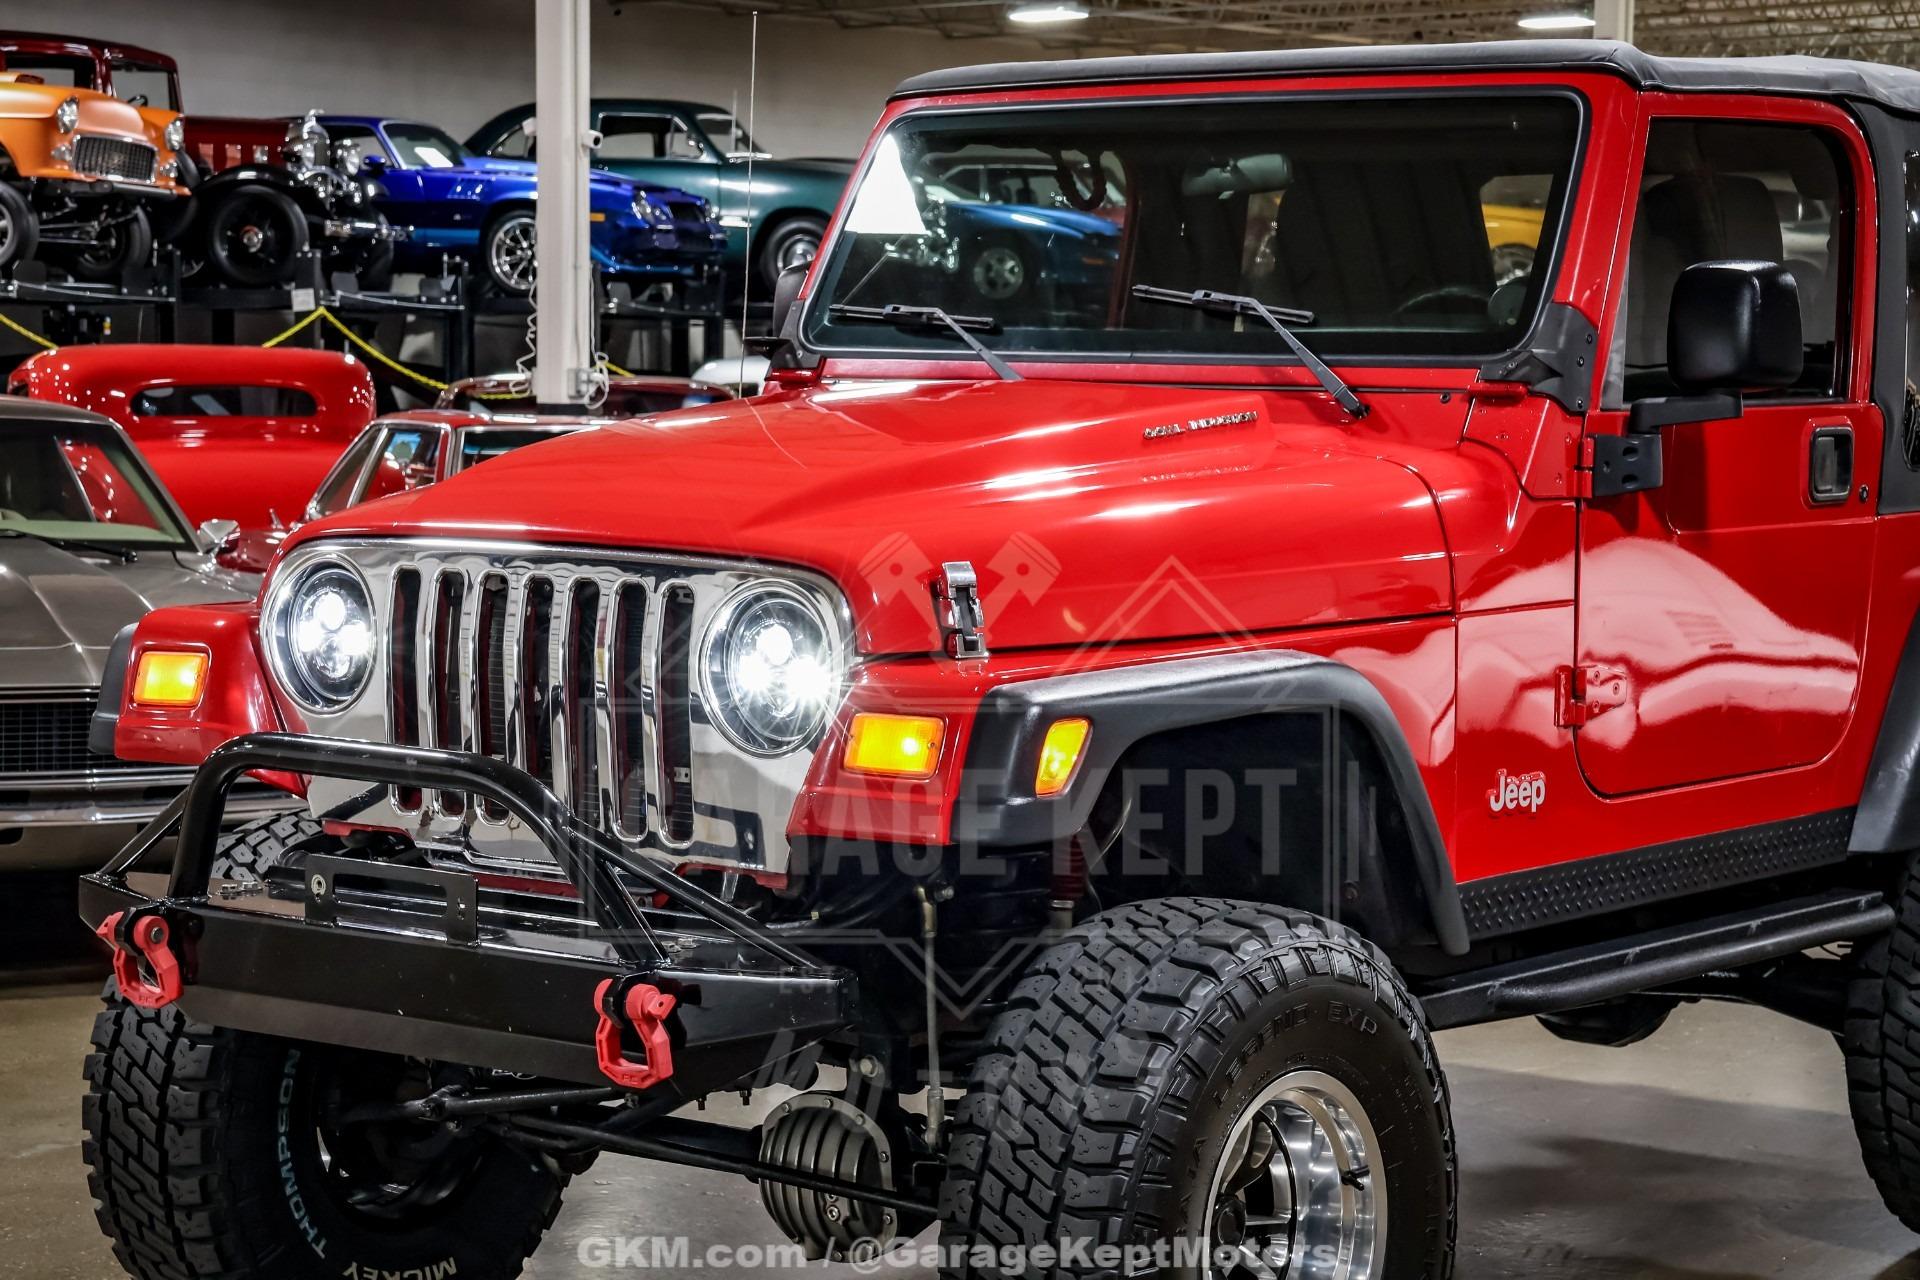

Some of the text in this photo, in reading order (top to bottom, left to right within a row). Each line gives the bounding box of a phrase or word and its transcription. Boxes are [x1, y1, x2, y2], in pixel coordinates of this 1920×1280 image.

[1486, 769, 1547, 813] Jeep
[1326, 1001, 1379, 1036] EXP
[277, 1048, 328, 1260] THOMPSON
